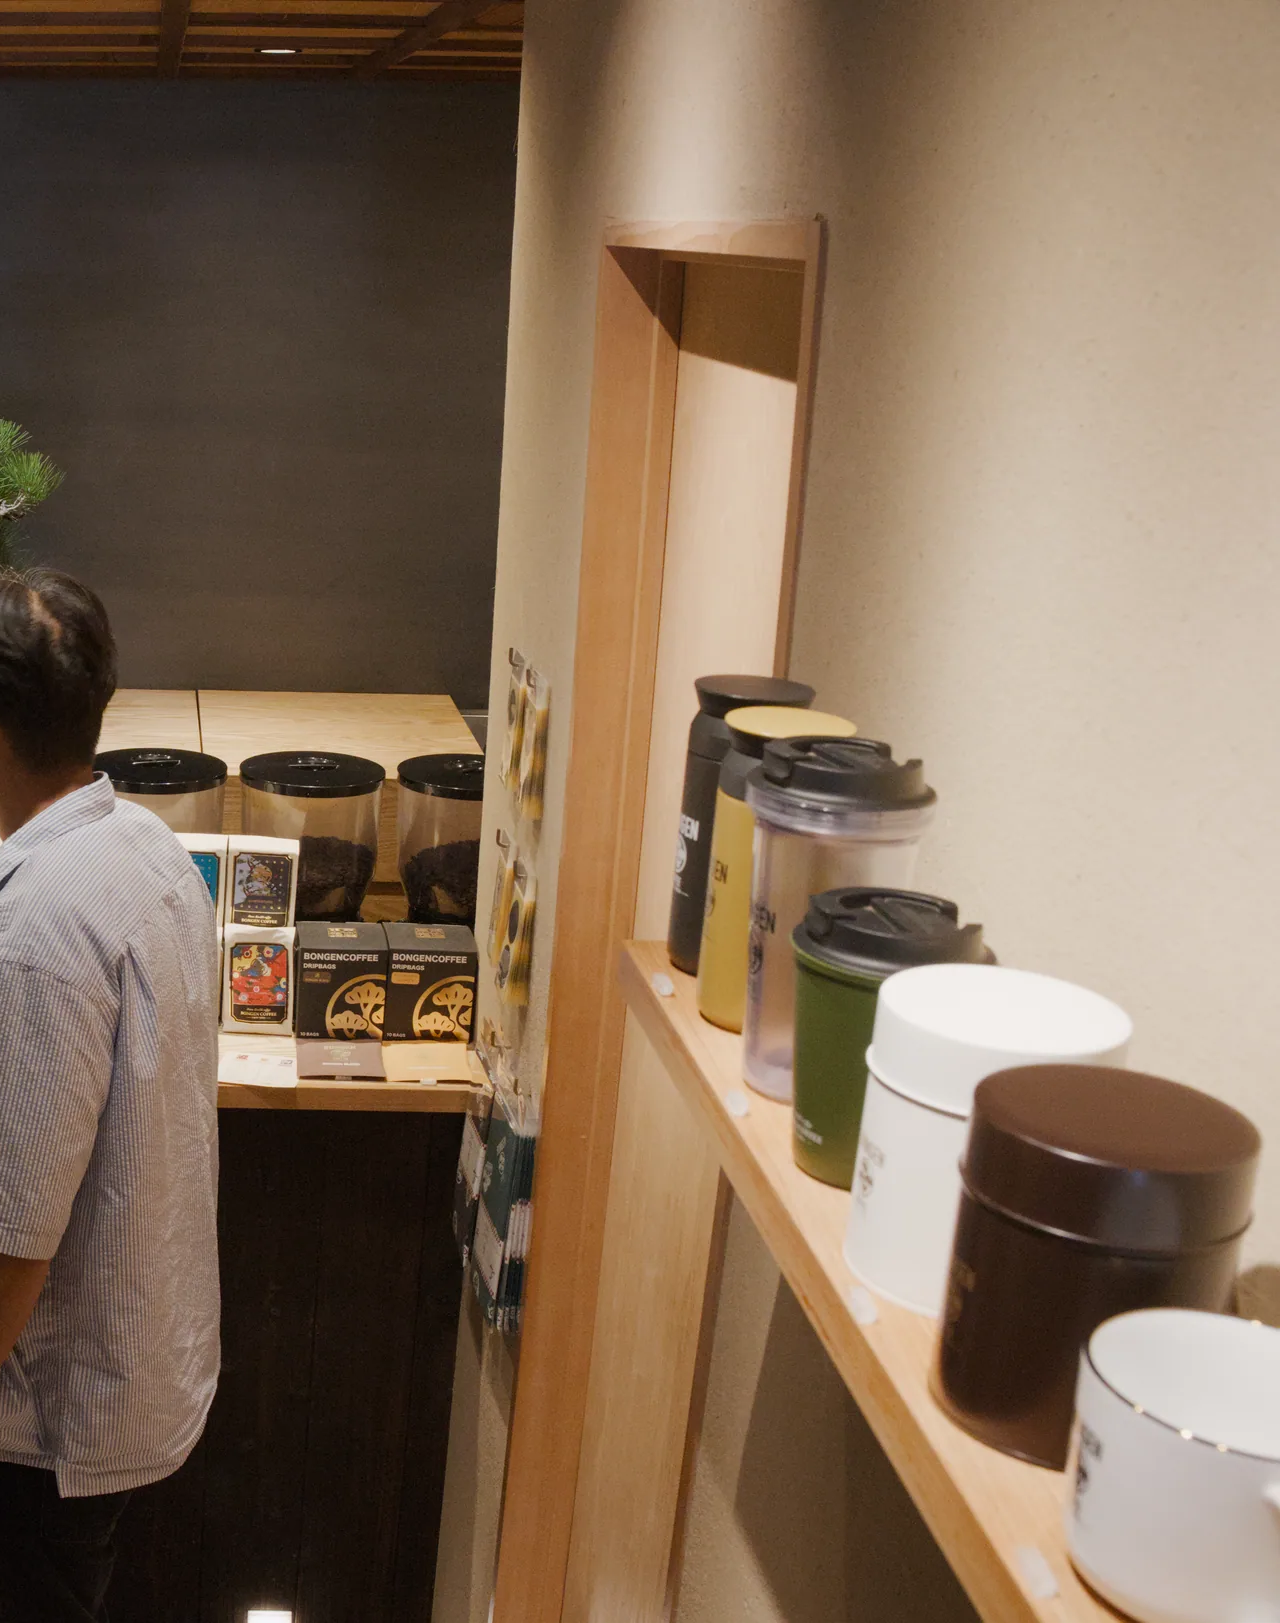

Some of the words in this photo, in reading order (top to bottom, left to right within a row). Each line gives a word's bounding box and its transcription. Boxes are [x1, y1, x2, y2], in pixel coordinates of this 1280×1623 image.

[303, 952, 379, 962] BONGENCOFFEE
[392, 952, 468, 964] BONGENCOFFEE
[391, 963, 425, 971] DRIPBAGS
